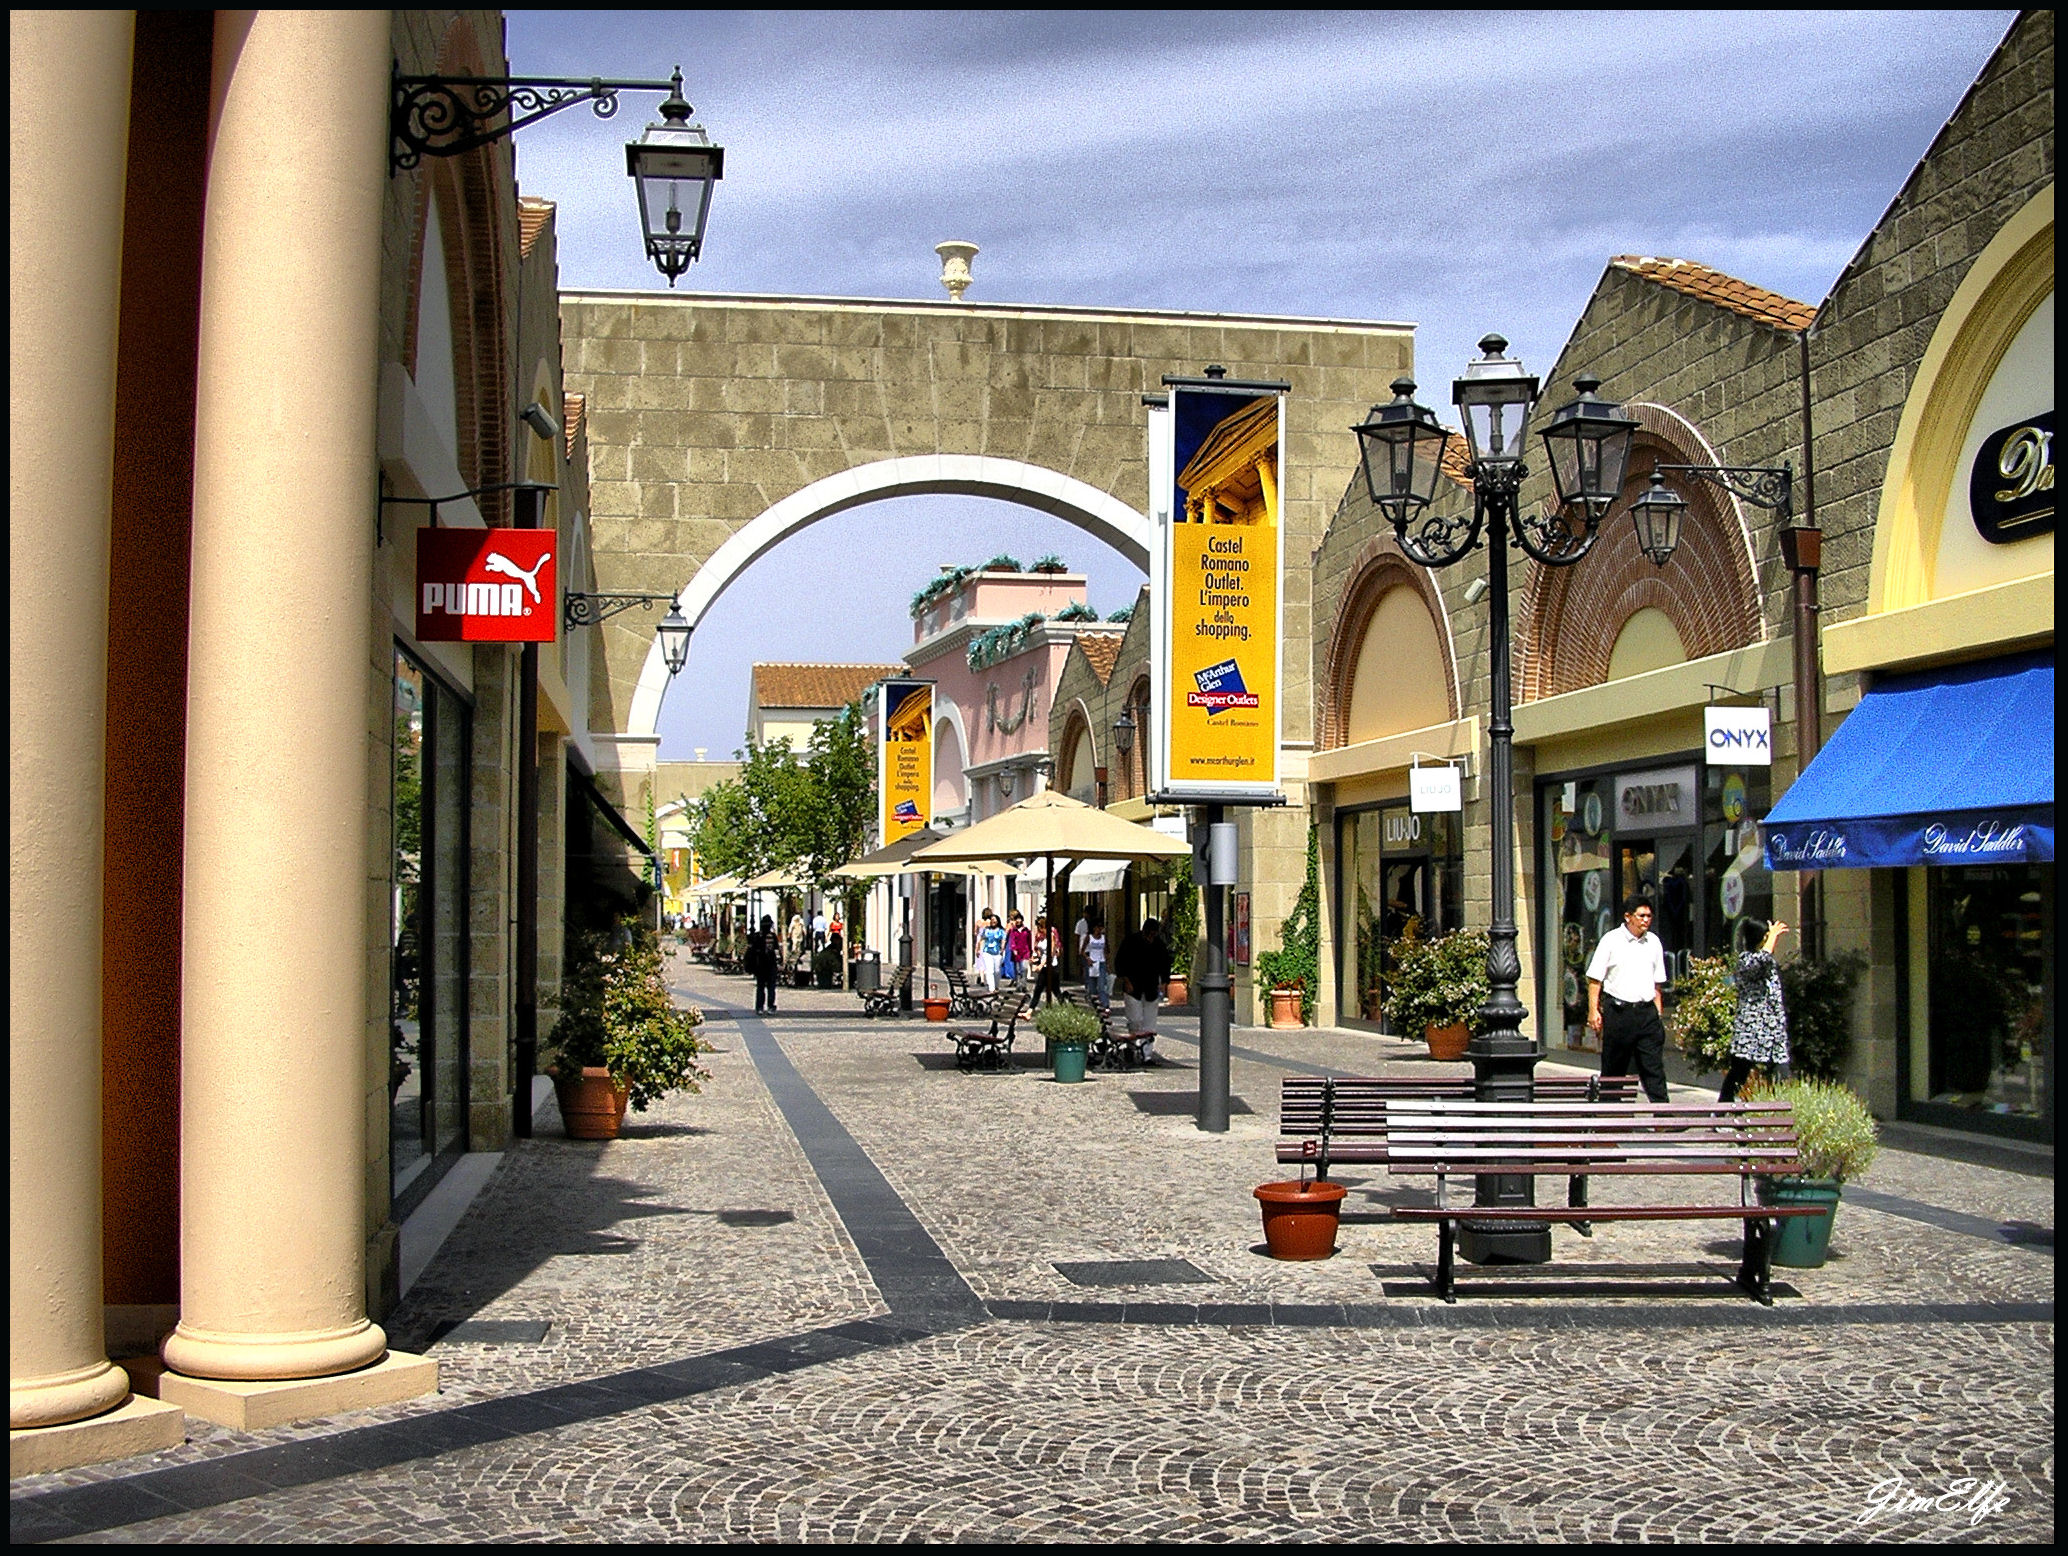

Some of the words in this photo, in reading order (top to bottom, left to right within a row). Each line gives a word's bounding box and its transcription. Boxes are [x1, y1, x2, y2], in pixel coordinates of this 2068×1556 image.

[1208, 536, 1243, 554] Castel
[1201, 554, 1250, 571] Romano
[1205, 572, 1244, 590] Outlet.
[423, 583, 523, 616] PUMA
[1200, 589, 1250, 609] L'impero
[1195, 618, 1252, 641] shopping.
[1196, 663, 1236, 684] McArthur
[1200, 679, 1222, 692] Glen
[1189, 694, 1226, 706] Designer
[1227, 694, 1258, 705] Outlets
[1710, 728, 1768, 748] ONYX
[1190, 756, 1255, 767] www.mcarthurglen.it
[1771, 833, 1809, 861] David
[1923, 822, 1976, 854] David
[1970, 820, 2024, 852] Saddler
